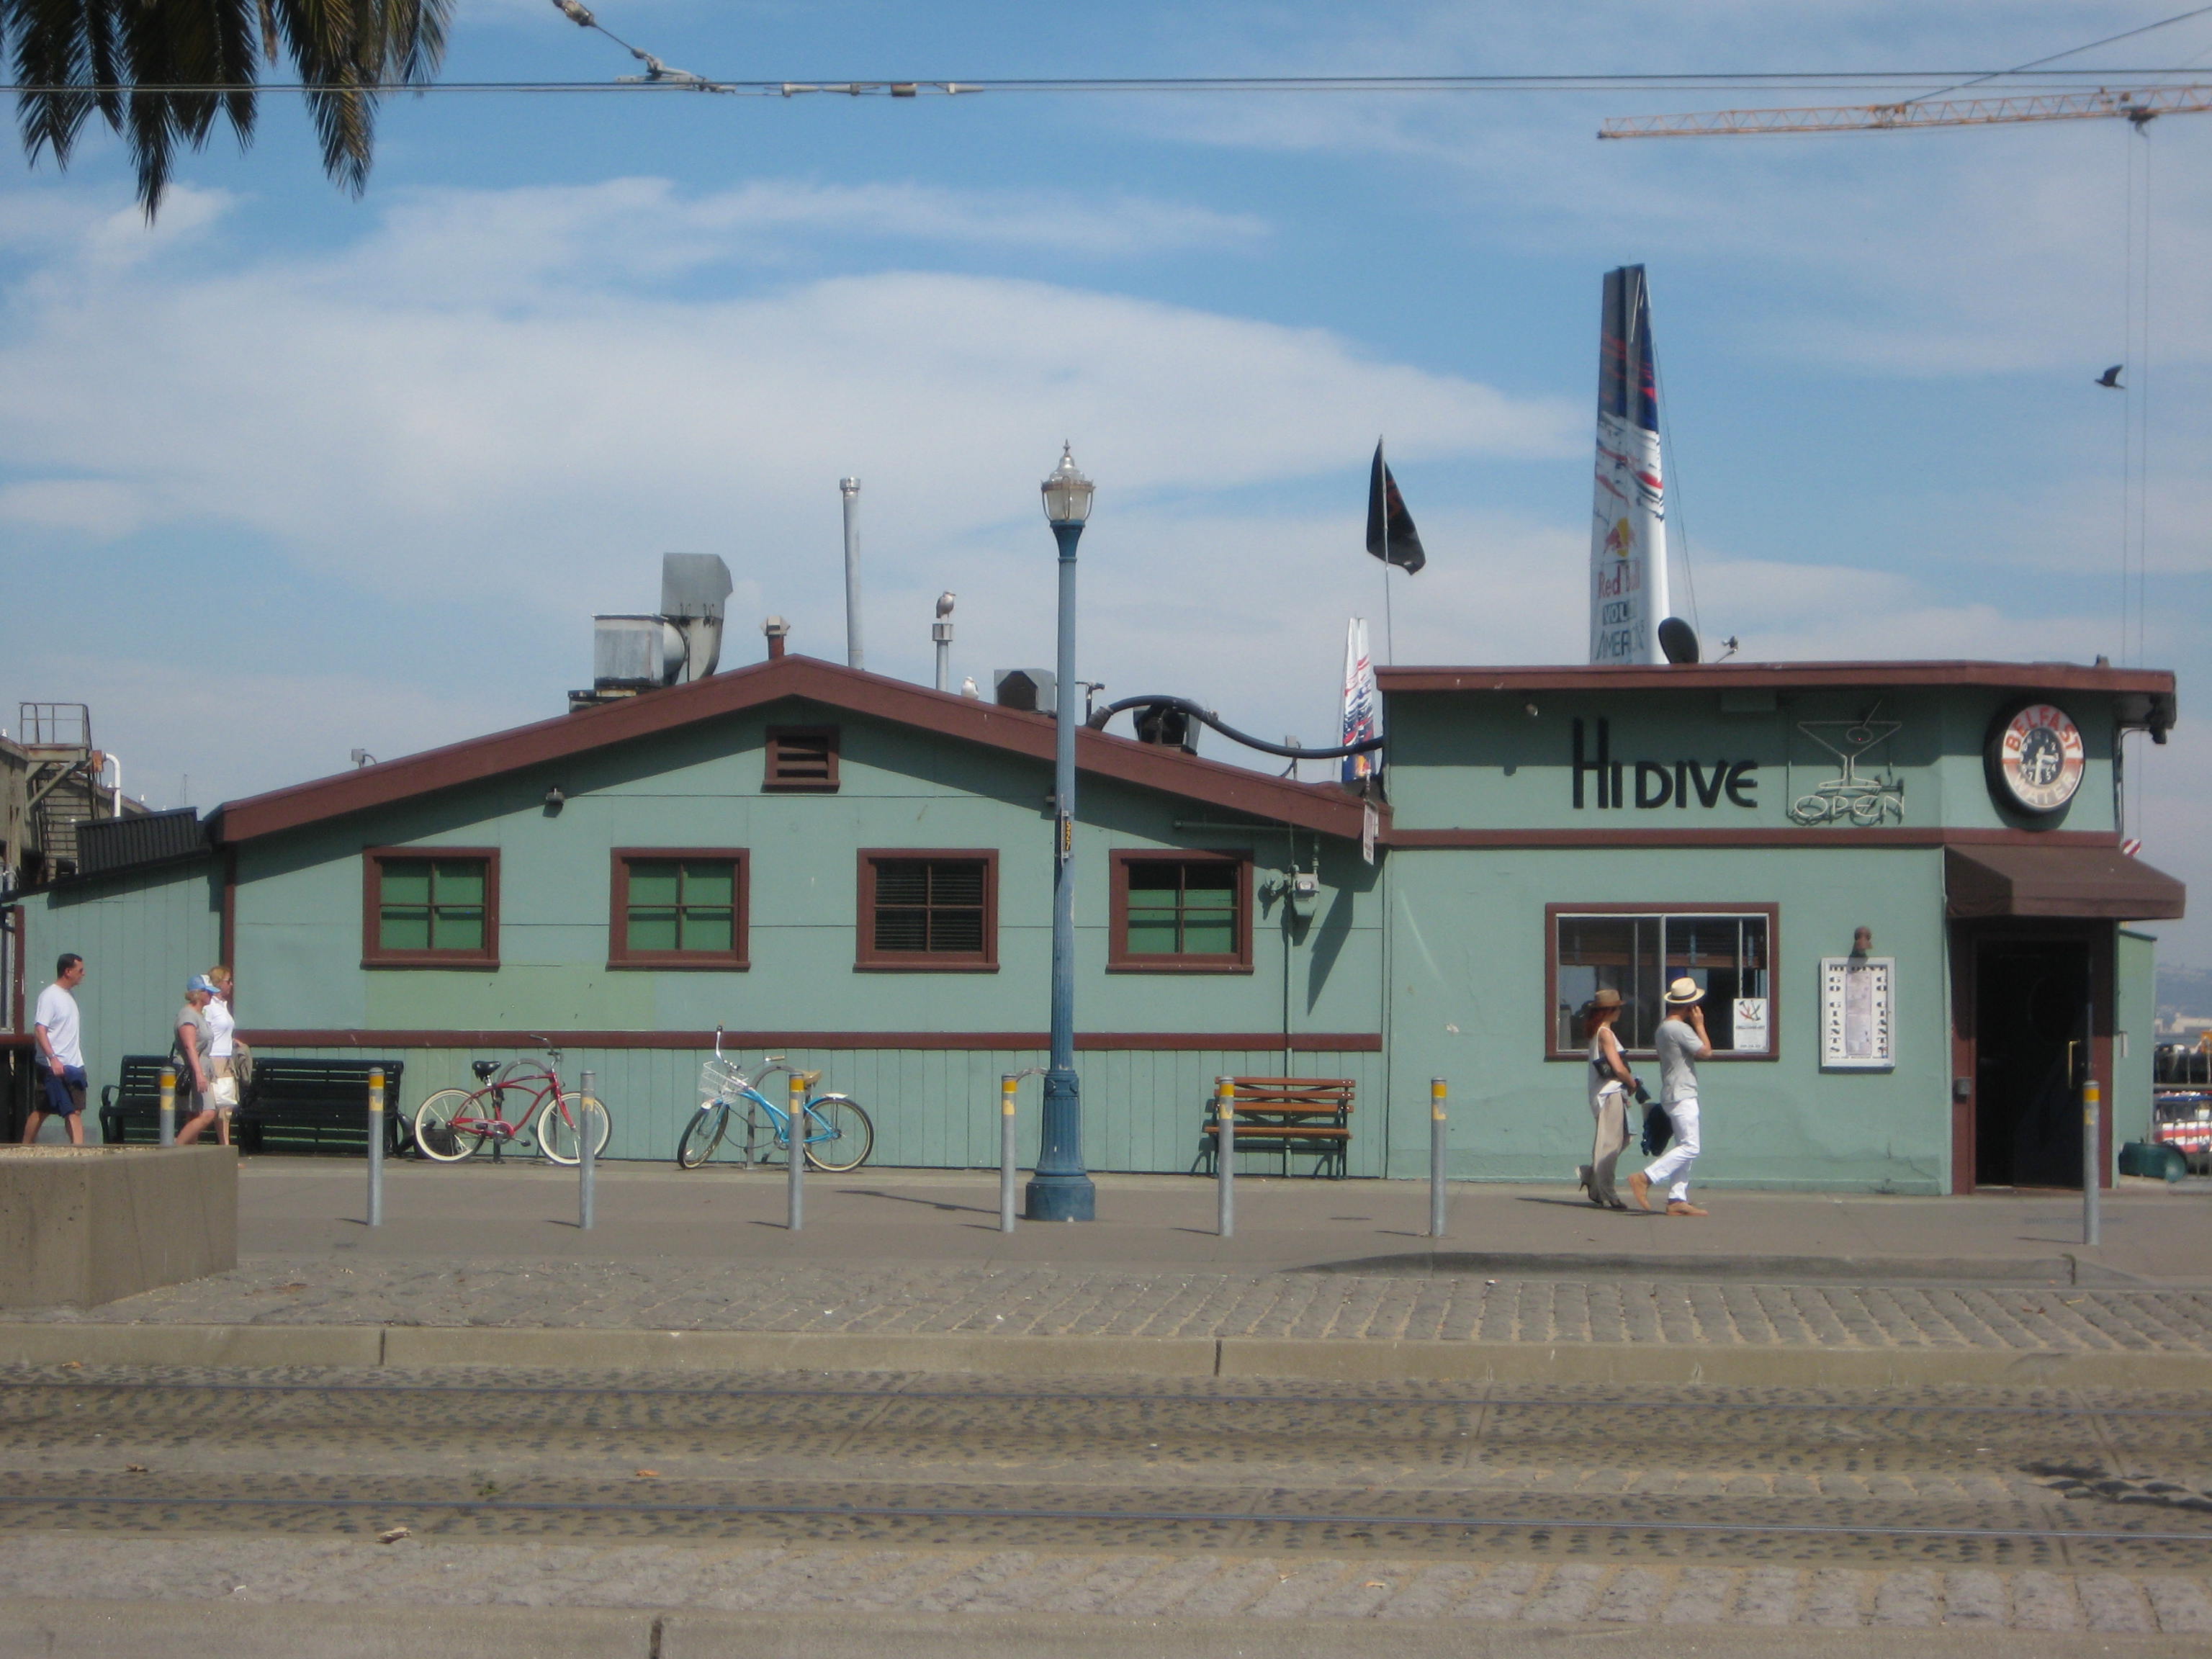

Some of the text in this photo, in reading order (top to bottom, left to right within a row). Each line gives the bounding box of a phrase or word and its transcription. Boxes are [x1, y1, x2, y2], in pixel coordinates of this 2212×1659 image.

[1598, 564, 1620, 599] Red
[2005, 706, 2082, 752] BELFAST
[1635, 760, 1758, 809] DIVE
[2013, 773, 2076, 804] WATER
[2045, 771, 2051, 781] 5
[1795, 795, 1905, 818] OPEN
[1829, 1002, 1841, 1053] GIANTS
